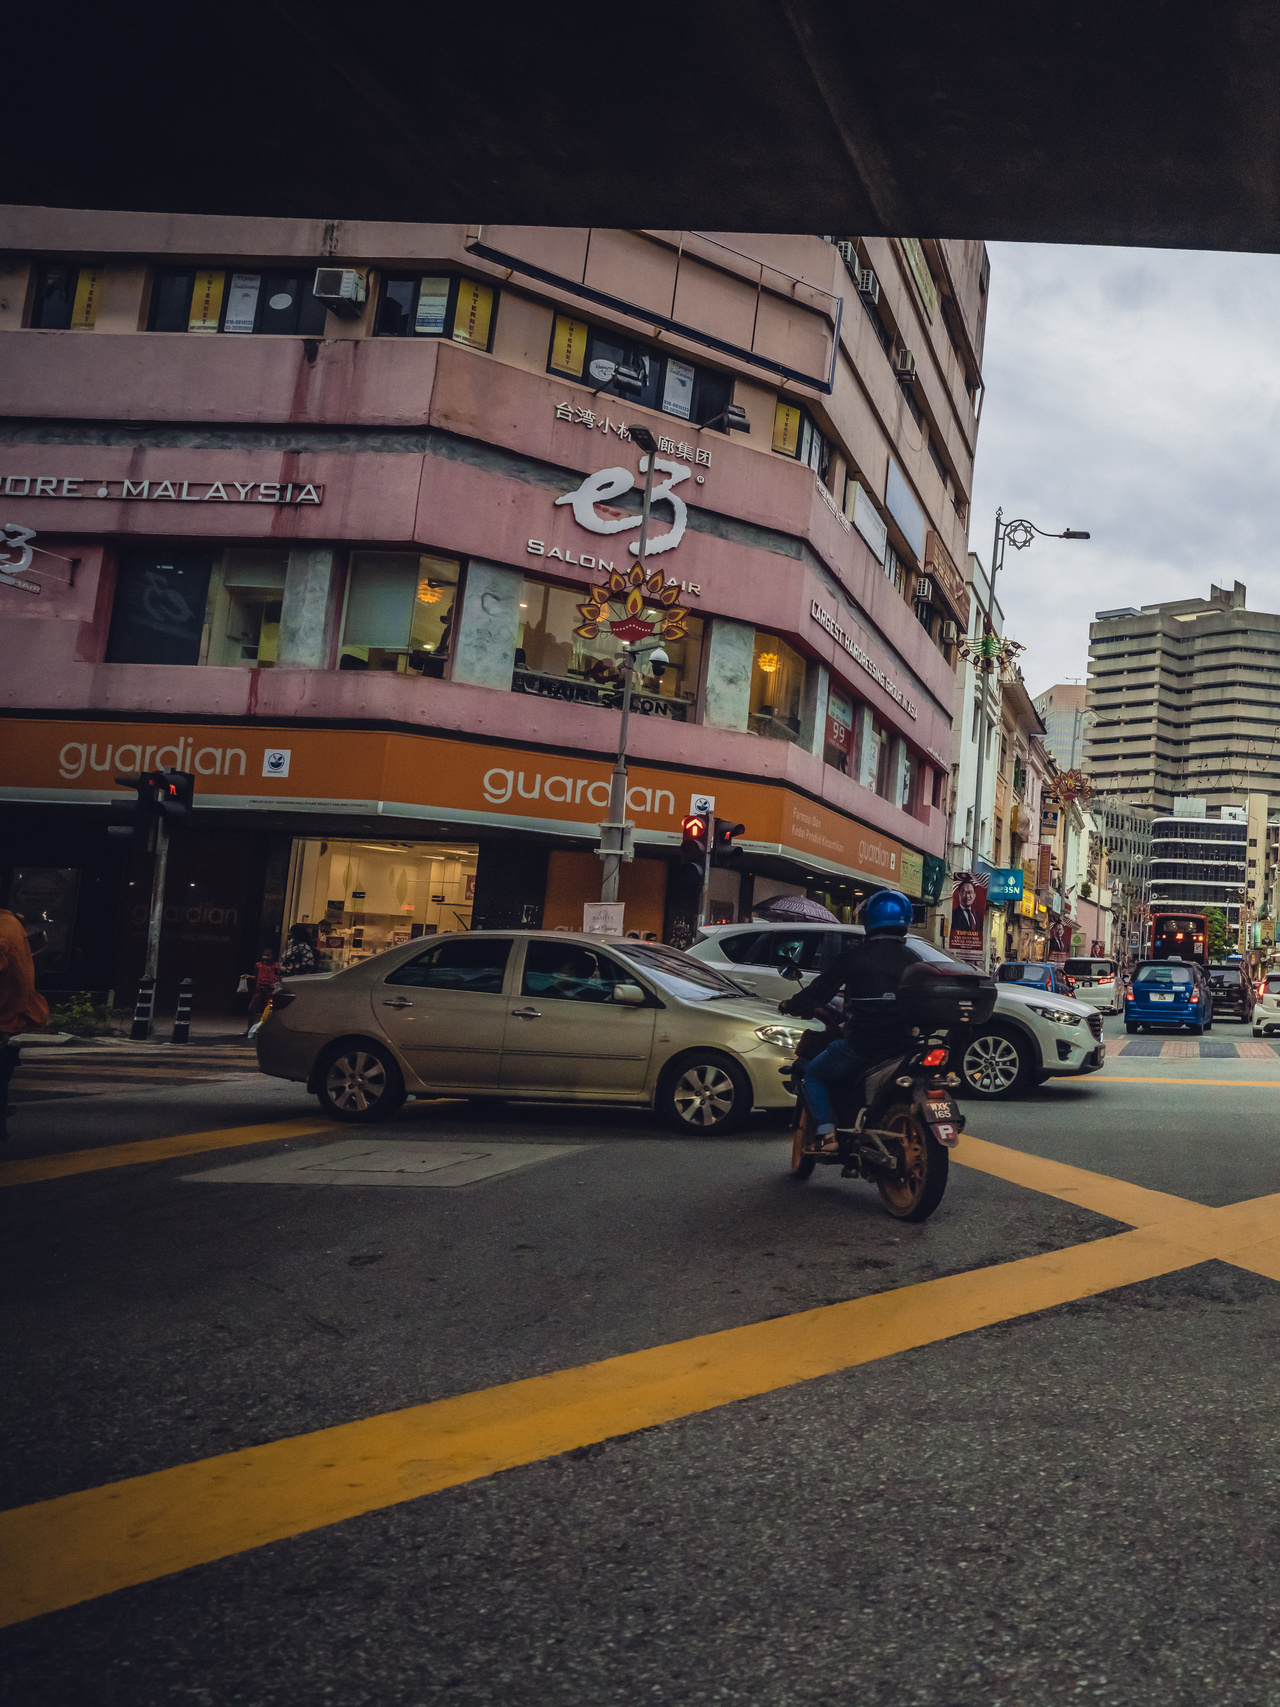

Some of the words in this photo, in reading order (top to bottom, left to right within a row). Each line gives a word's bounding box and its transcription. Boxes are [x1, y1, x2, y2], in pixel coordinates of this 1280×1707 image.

[202, 273, 214, 325] INTERNET
[467, 285, 479, 338] INTERNET
[565, 321, 575, 366] INTERNET
[0, 475, 84, 497] ORE
[122, 478, 322, 504] MALAYSIA
[526, 538, 615, 573] SALON
[811, 600, 844, 644] LARGEST
[832, 721, 846, 744] 99
[59, 737, 247, 780] guardian
[858, 838, 889, 871] guardian
[131, 901, 238, 926] gardian
[934, 1110, 952, 1119] 165
[937, 1124, 954, 1140] P
